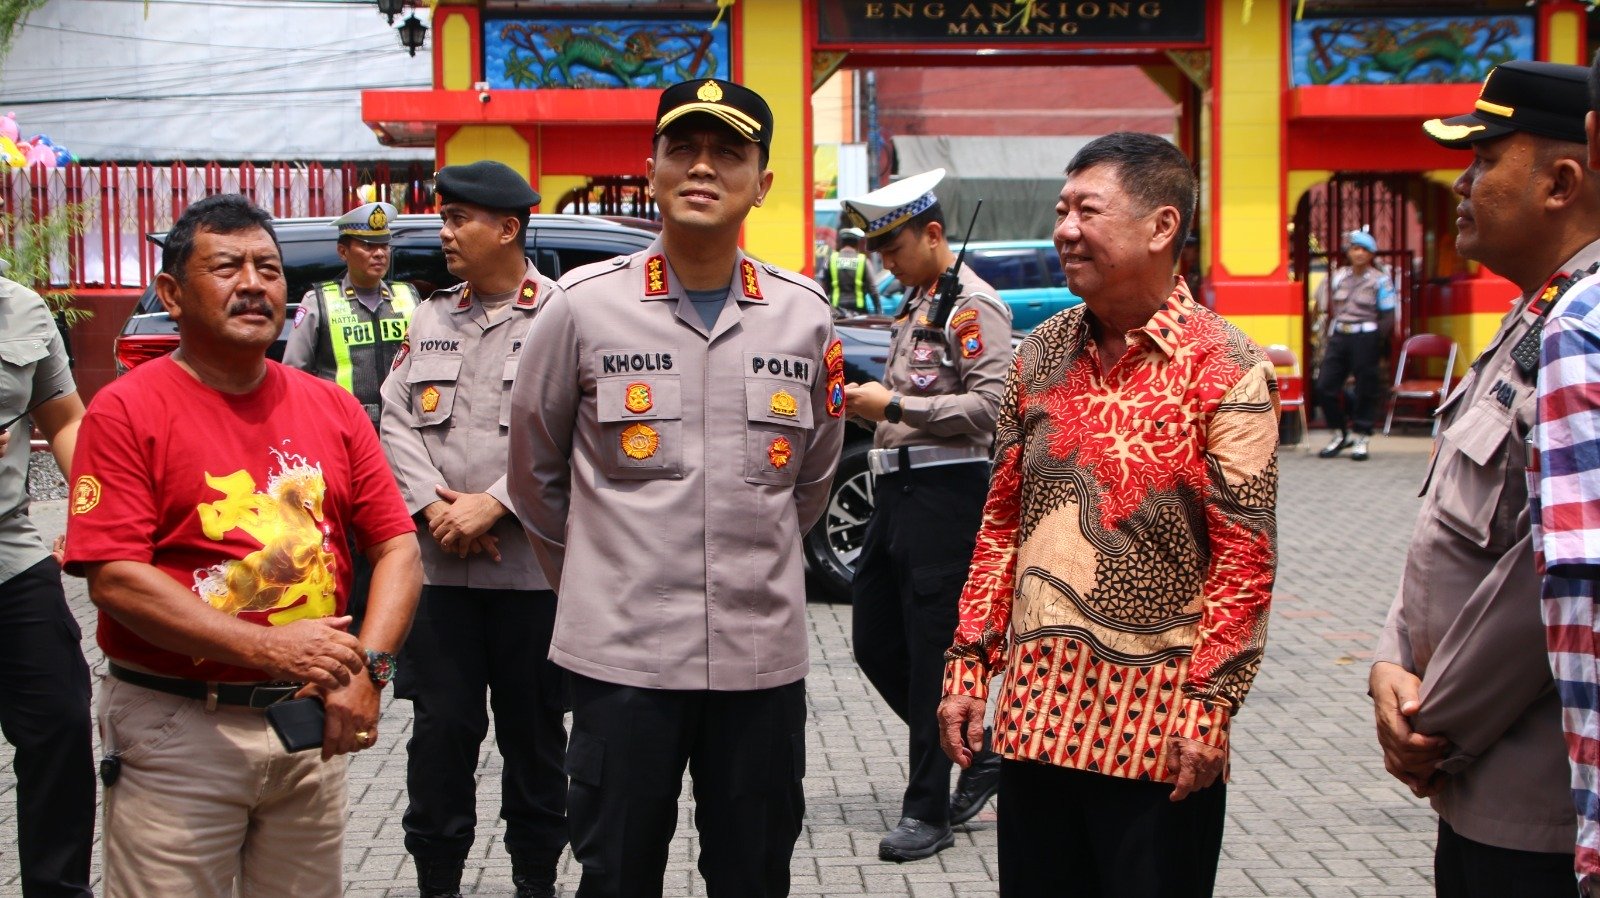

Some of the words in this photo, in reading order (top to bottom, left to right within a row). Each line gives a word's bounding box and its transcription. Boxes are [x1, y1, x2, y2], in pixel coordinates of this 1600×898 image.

[865, 2, 945, 19] ENG
[960, 2, 1011, 19] AN
[1030, 2, 1162, 18] KIONG
[948, 22, 1079, 35] MALANG
[420, 340, 460, 351] YOYOK
[603, 352, 673, 373] KHOLIS
[752, 356, 809, 380] POLRI
